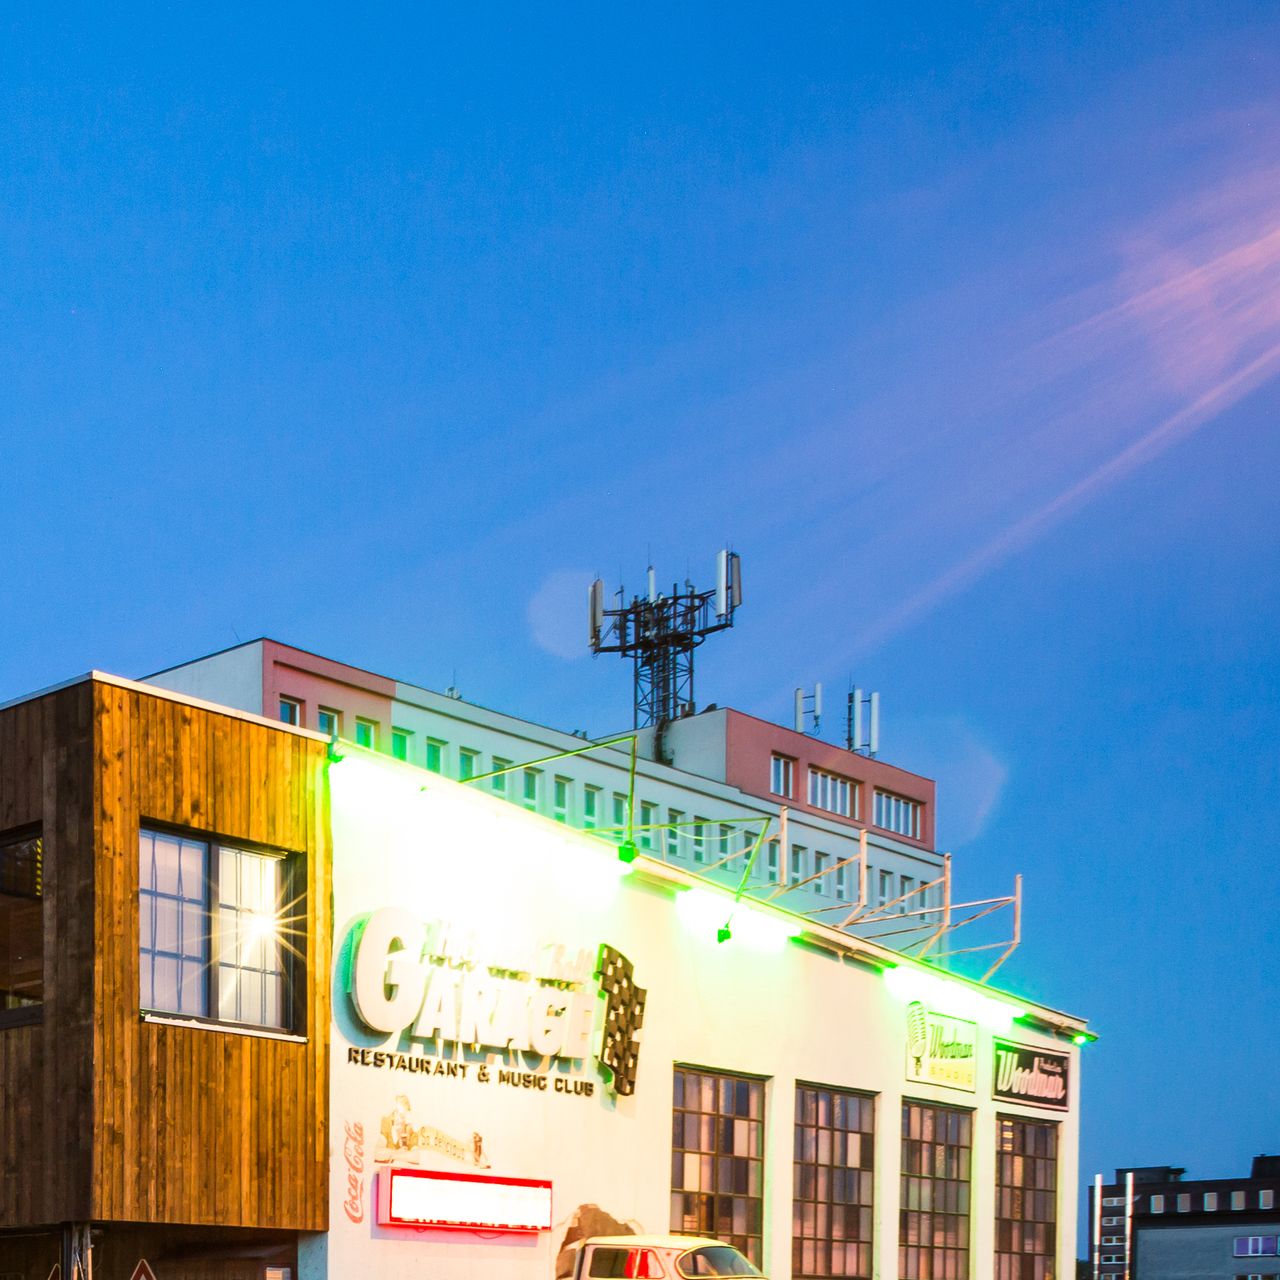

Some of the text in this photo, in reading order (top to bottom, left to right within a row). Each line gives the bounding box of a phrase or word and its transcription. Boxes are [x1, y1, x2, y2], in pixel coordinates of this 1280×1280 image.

[347, 1047, 595, 1097] RESTAURANT & MUSIC CLUB
[996, 1050, 1066, 1100] Woodman
